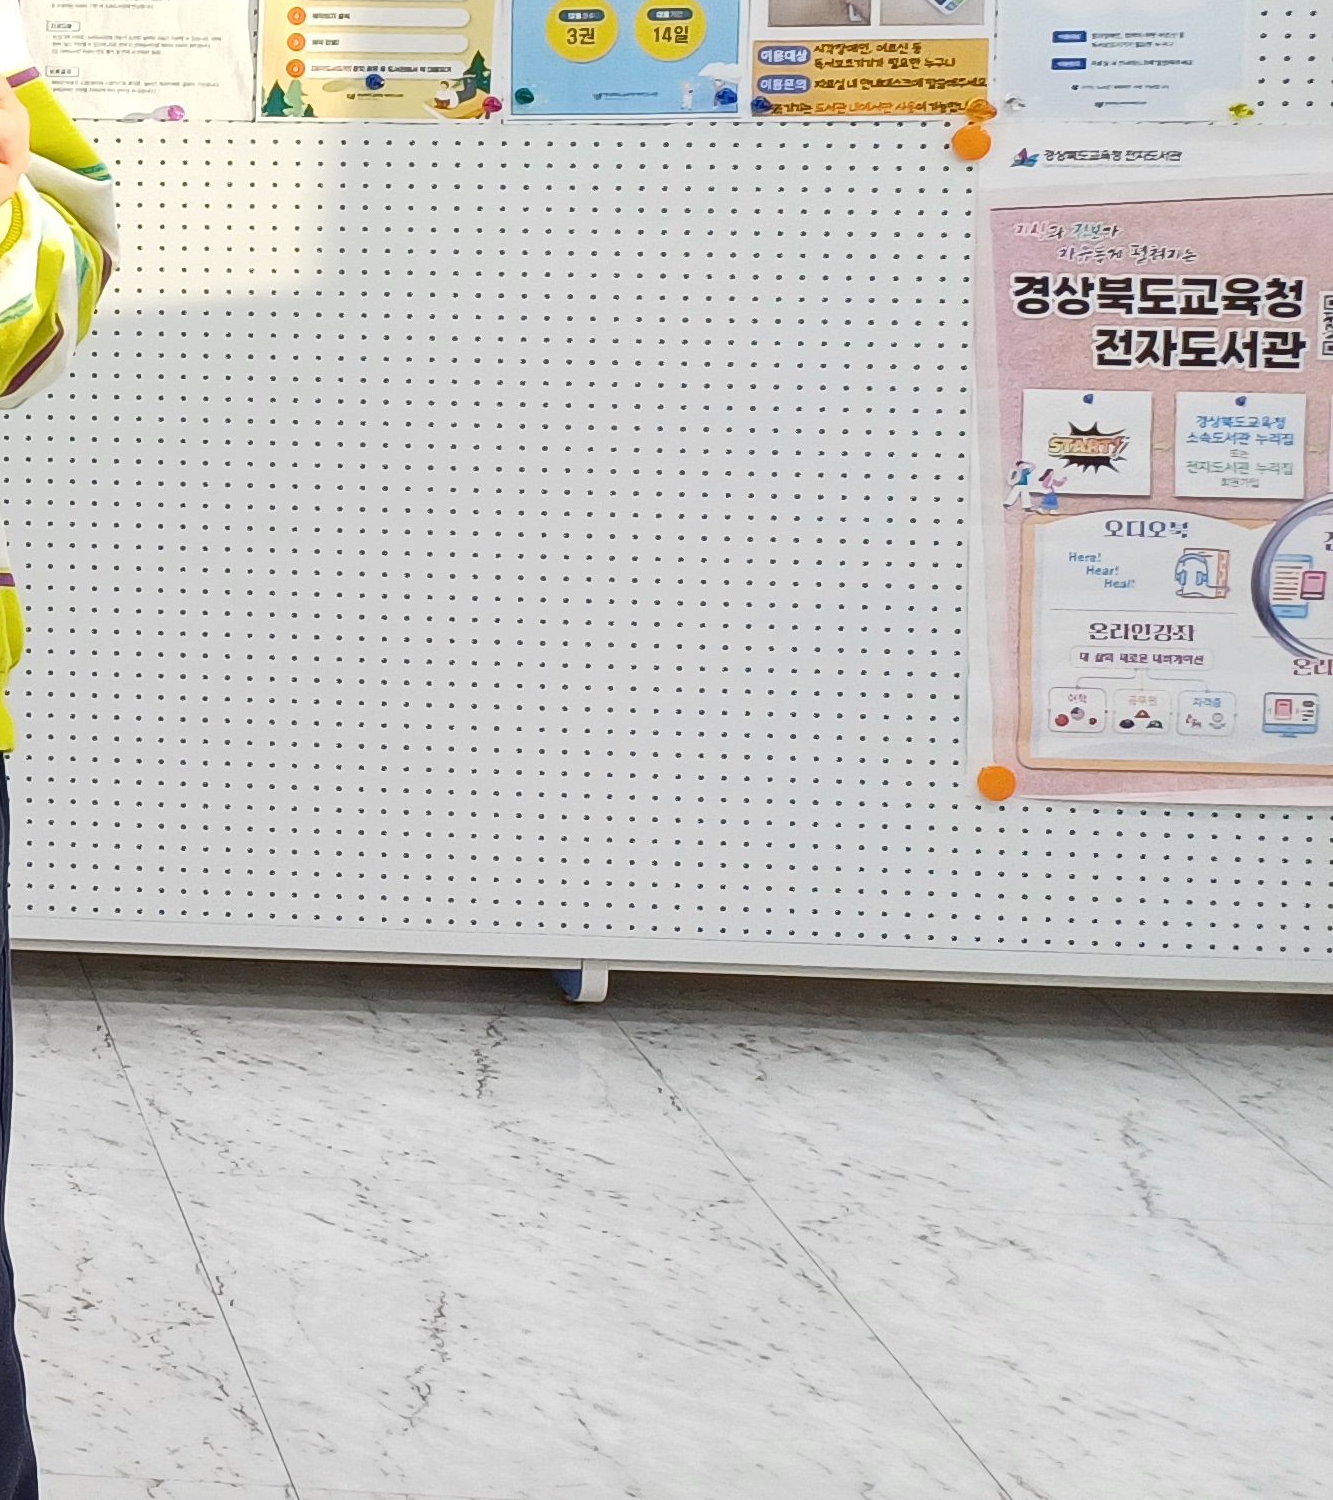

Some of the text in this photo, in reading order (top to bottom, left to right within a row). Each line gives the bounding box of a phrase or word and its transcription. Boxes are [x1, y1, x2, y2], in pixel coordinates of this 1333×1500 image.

[567, 27, 595, 45] 3권
[654, 26, 689, 44] 14일
[1013, 275, 1304, 319] 경상북도교육청
[1094, 328, 1308, 369] 전자도서관
[1104, 520, 1190, 539] 오디오북
[1088, 622, 1198, 643] 온라인강좌
